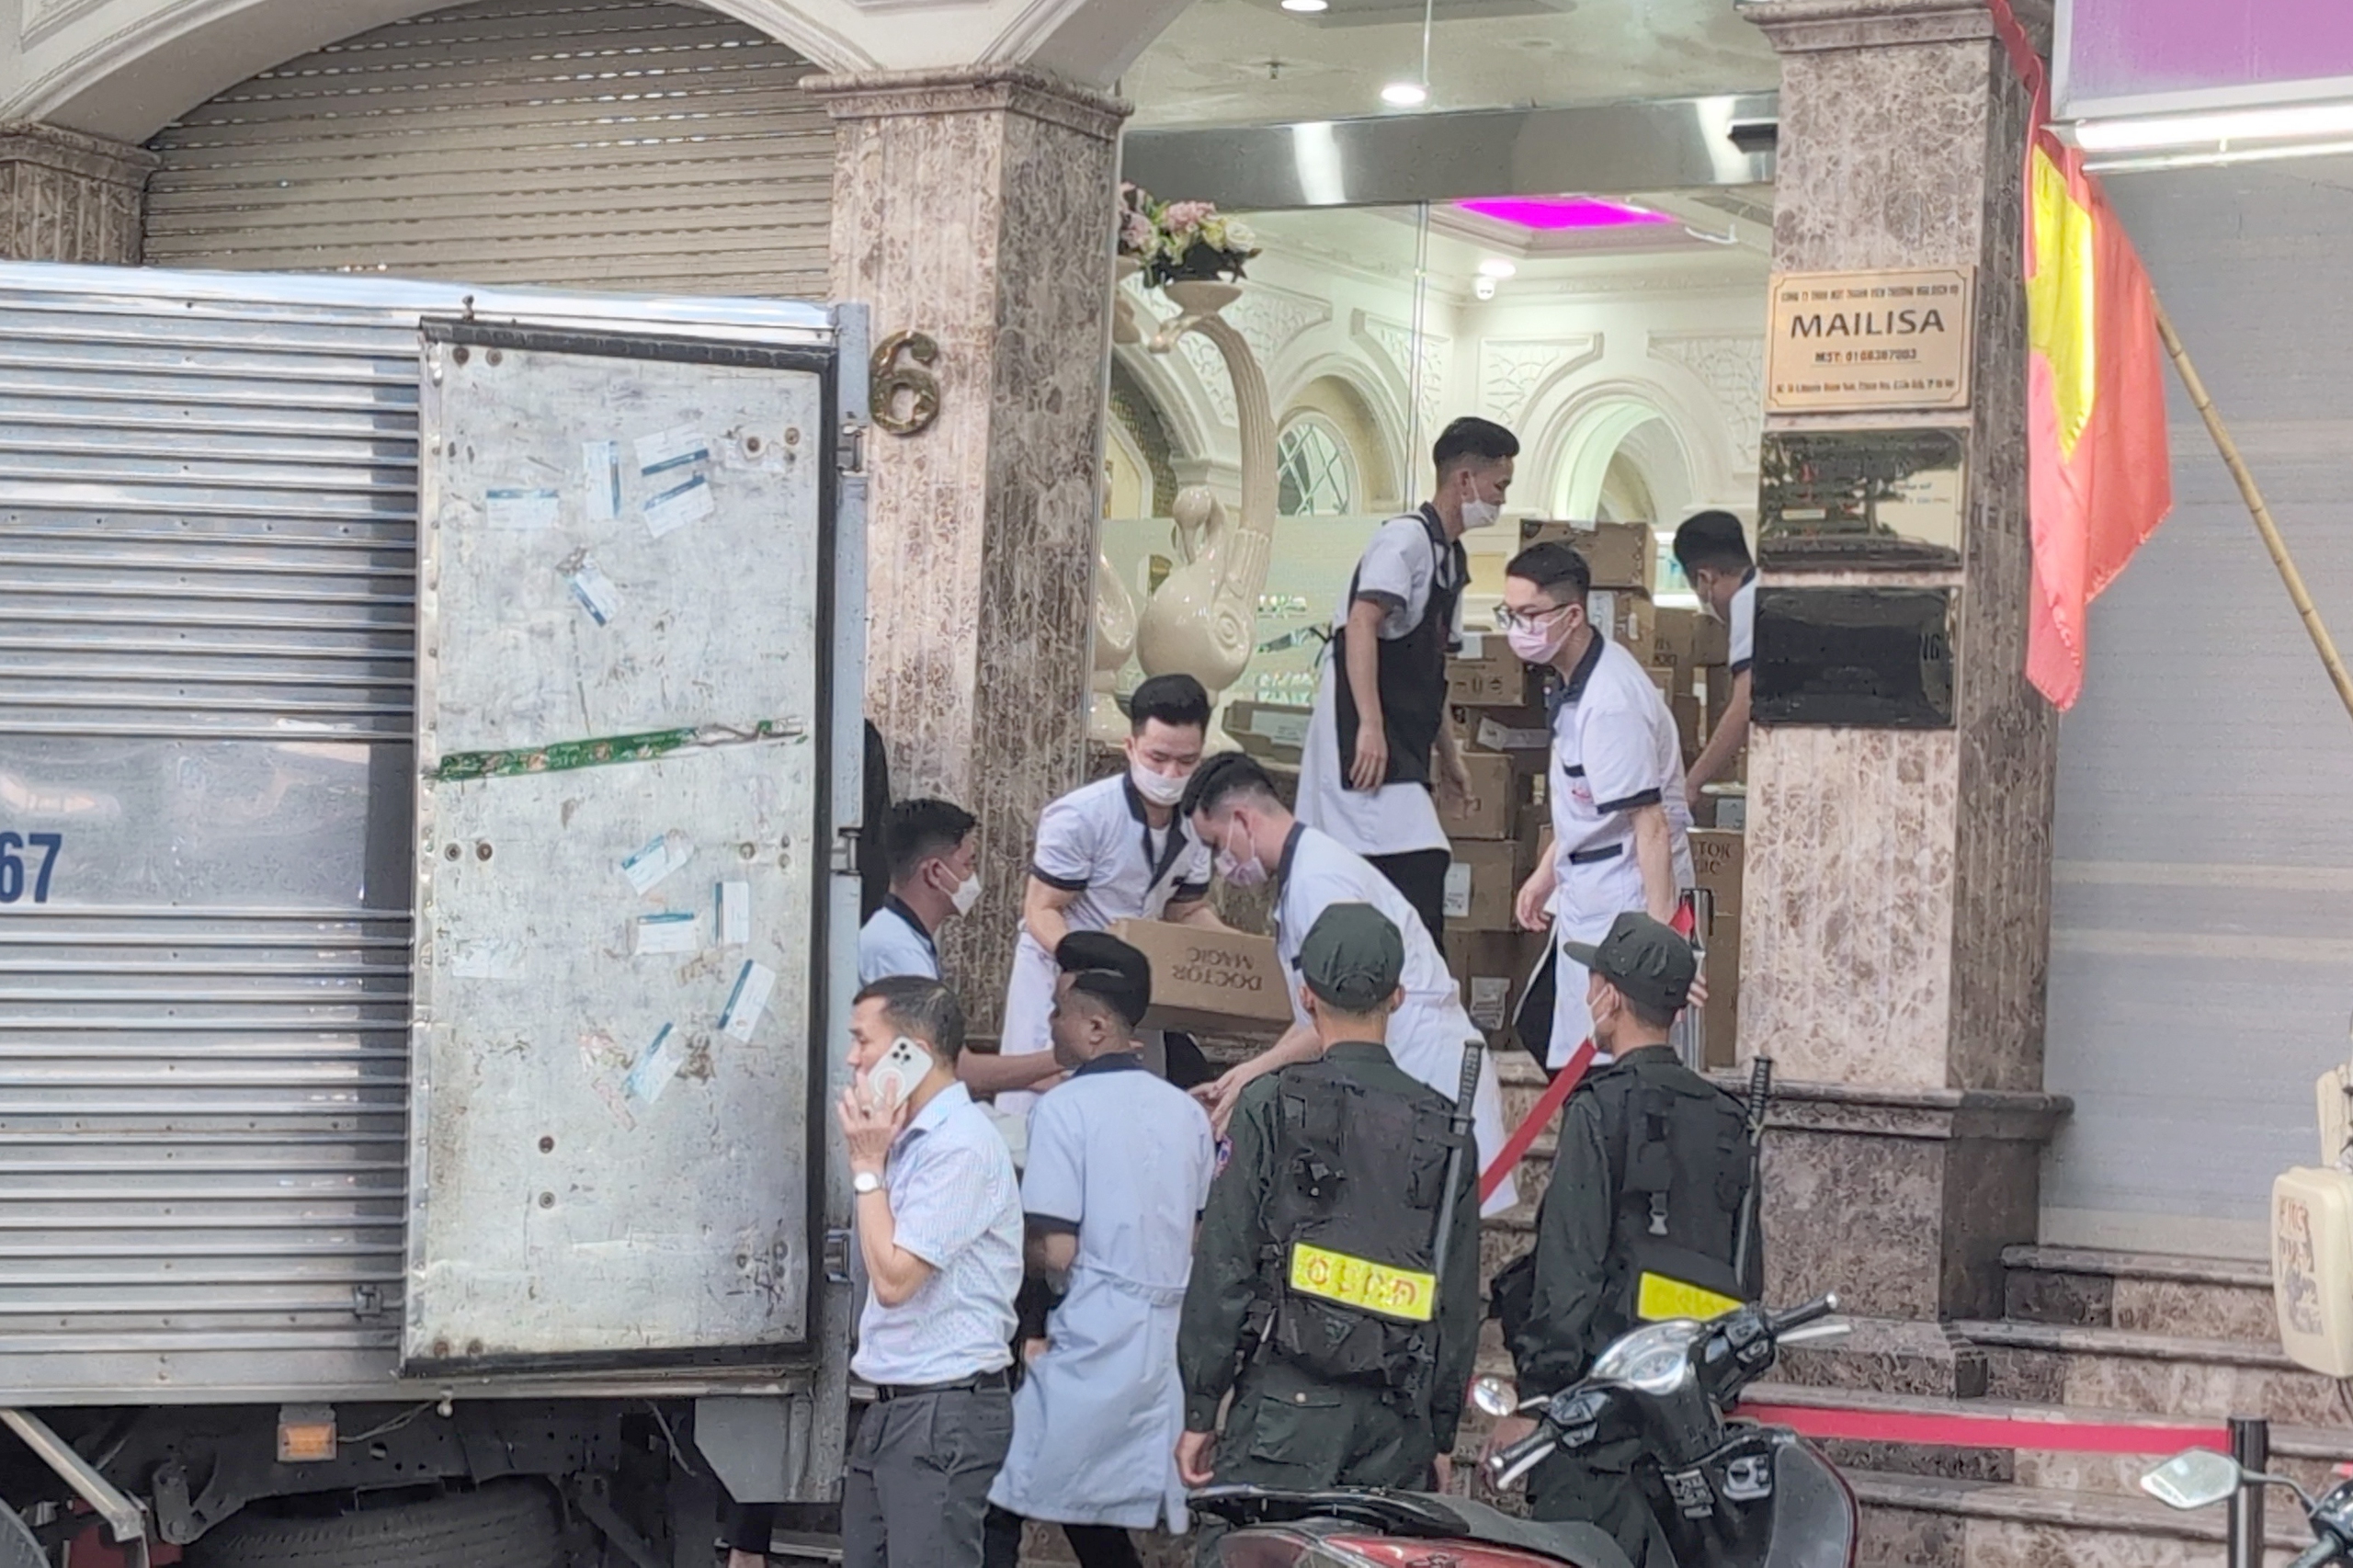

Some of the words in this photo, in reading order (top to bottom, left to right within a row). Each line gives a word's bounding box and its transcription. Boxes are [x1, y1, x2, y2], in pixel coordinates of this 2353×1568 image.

[1790, 309, 1945, 339] MAILISA
[869, 329, 939, 437] 6
[0, 831, 62, 903] 67
[1172, 964, 1263, 992] DOCTOR
